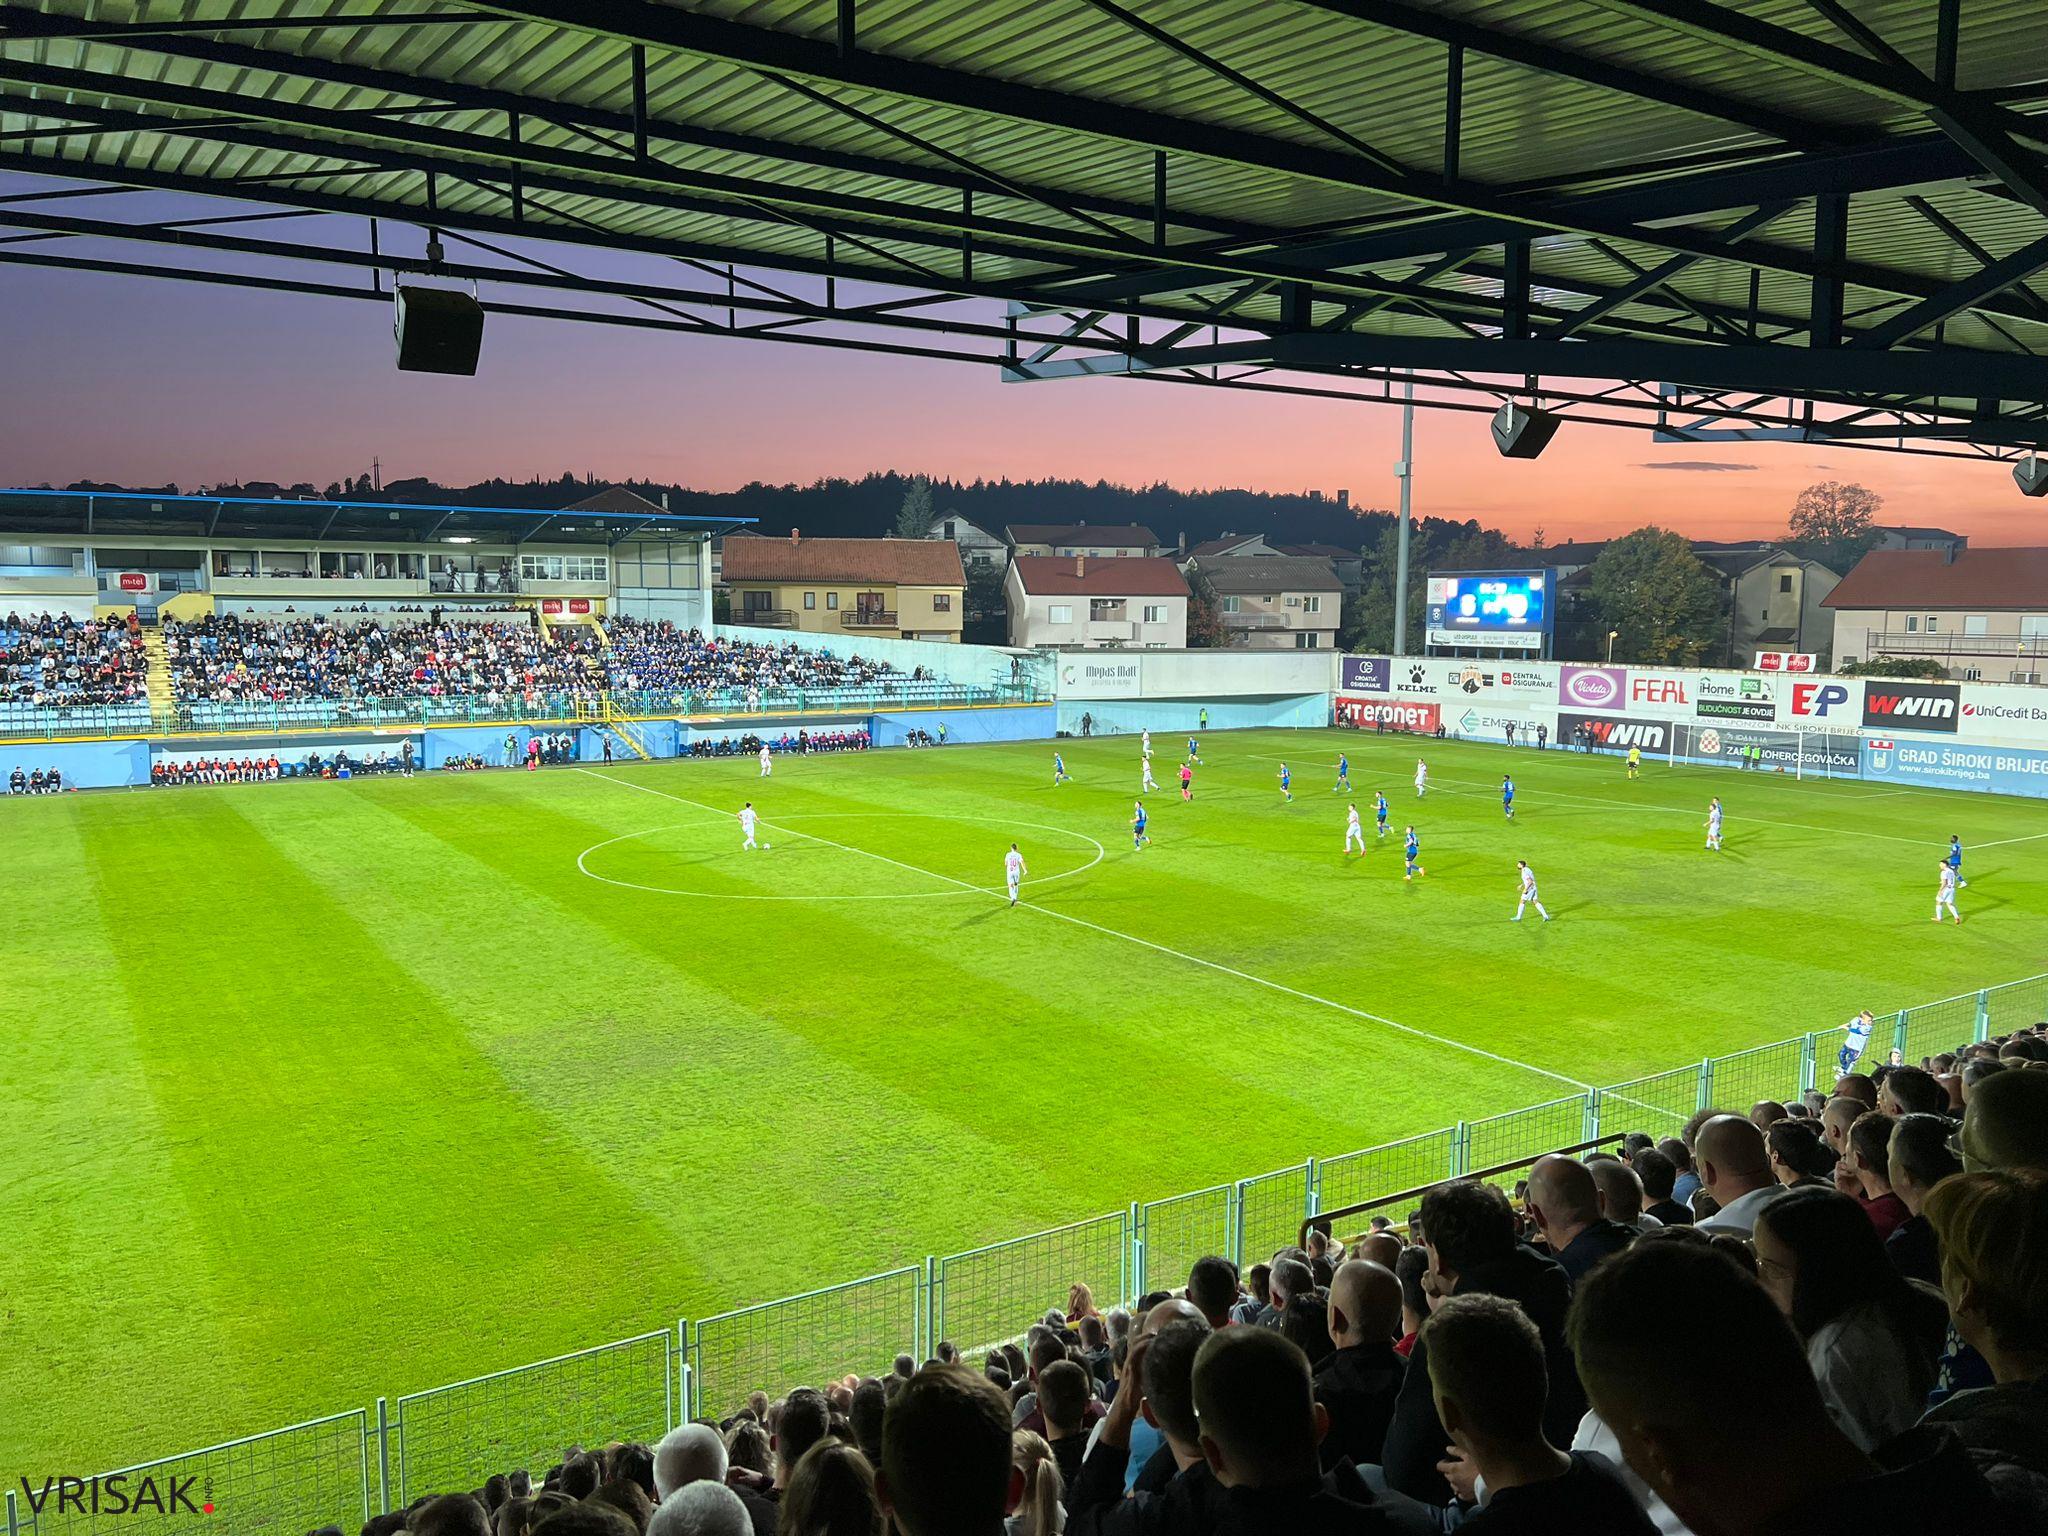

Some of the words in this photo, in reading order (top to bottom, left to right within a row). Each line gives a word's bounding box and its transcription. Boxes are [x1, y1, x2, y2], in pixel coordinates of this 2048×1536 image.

[1085, 665, 1115, 679] Mepas
[1512, 672, 1542, 680] CENTRAL
[1397, 684, 1437, 693] KELME
[1512, 680, 1553, 689] OSIGURANJE
[1577, 680, 1607, 694] Violeta
[1633, 678, 1689, 705] FEAL
[1700, 682, 1735, 696] iHome
[1792, 683, 1848, 717] EP
[1699, 703, 1742, 714] BUDUĆNOST
[1742, 707, 1750, 715] JE
[1750, 707, 1774, 717] OVDJE
[1976, 705, 2028, 719] UniCredit
[1689, 717, 1723, 725] GLAVNI
[1725, 718, 1771, 729] SPONZOR
[1776, 723, 1791, 731] NK
[1795, 722, 1827, 733] ŠIROKI
[1831, 727, 1865, 736] BRIJEG
[1898, 749, 1938, 765] GRAD
[1942, 748, 1992, 769] ŠIROKI
[1996, 757, 2048, 774] BRIJEG
[1898, 764, 1991, 780] www.sirokibrijeg.ba
